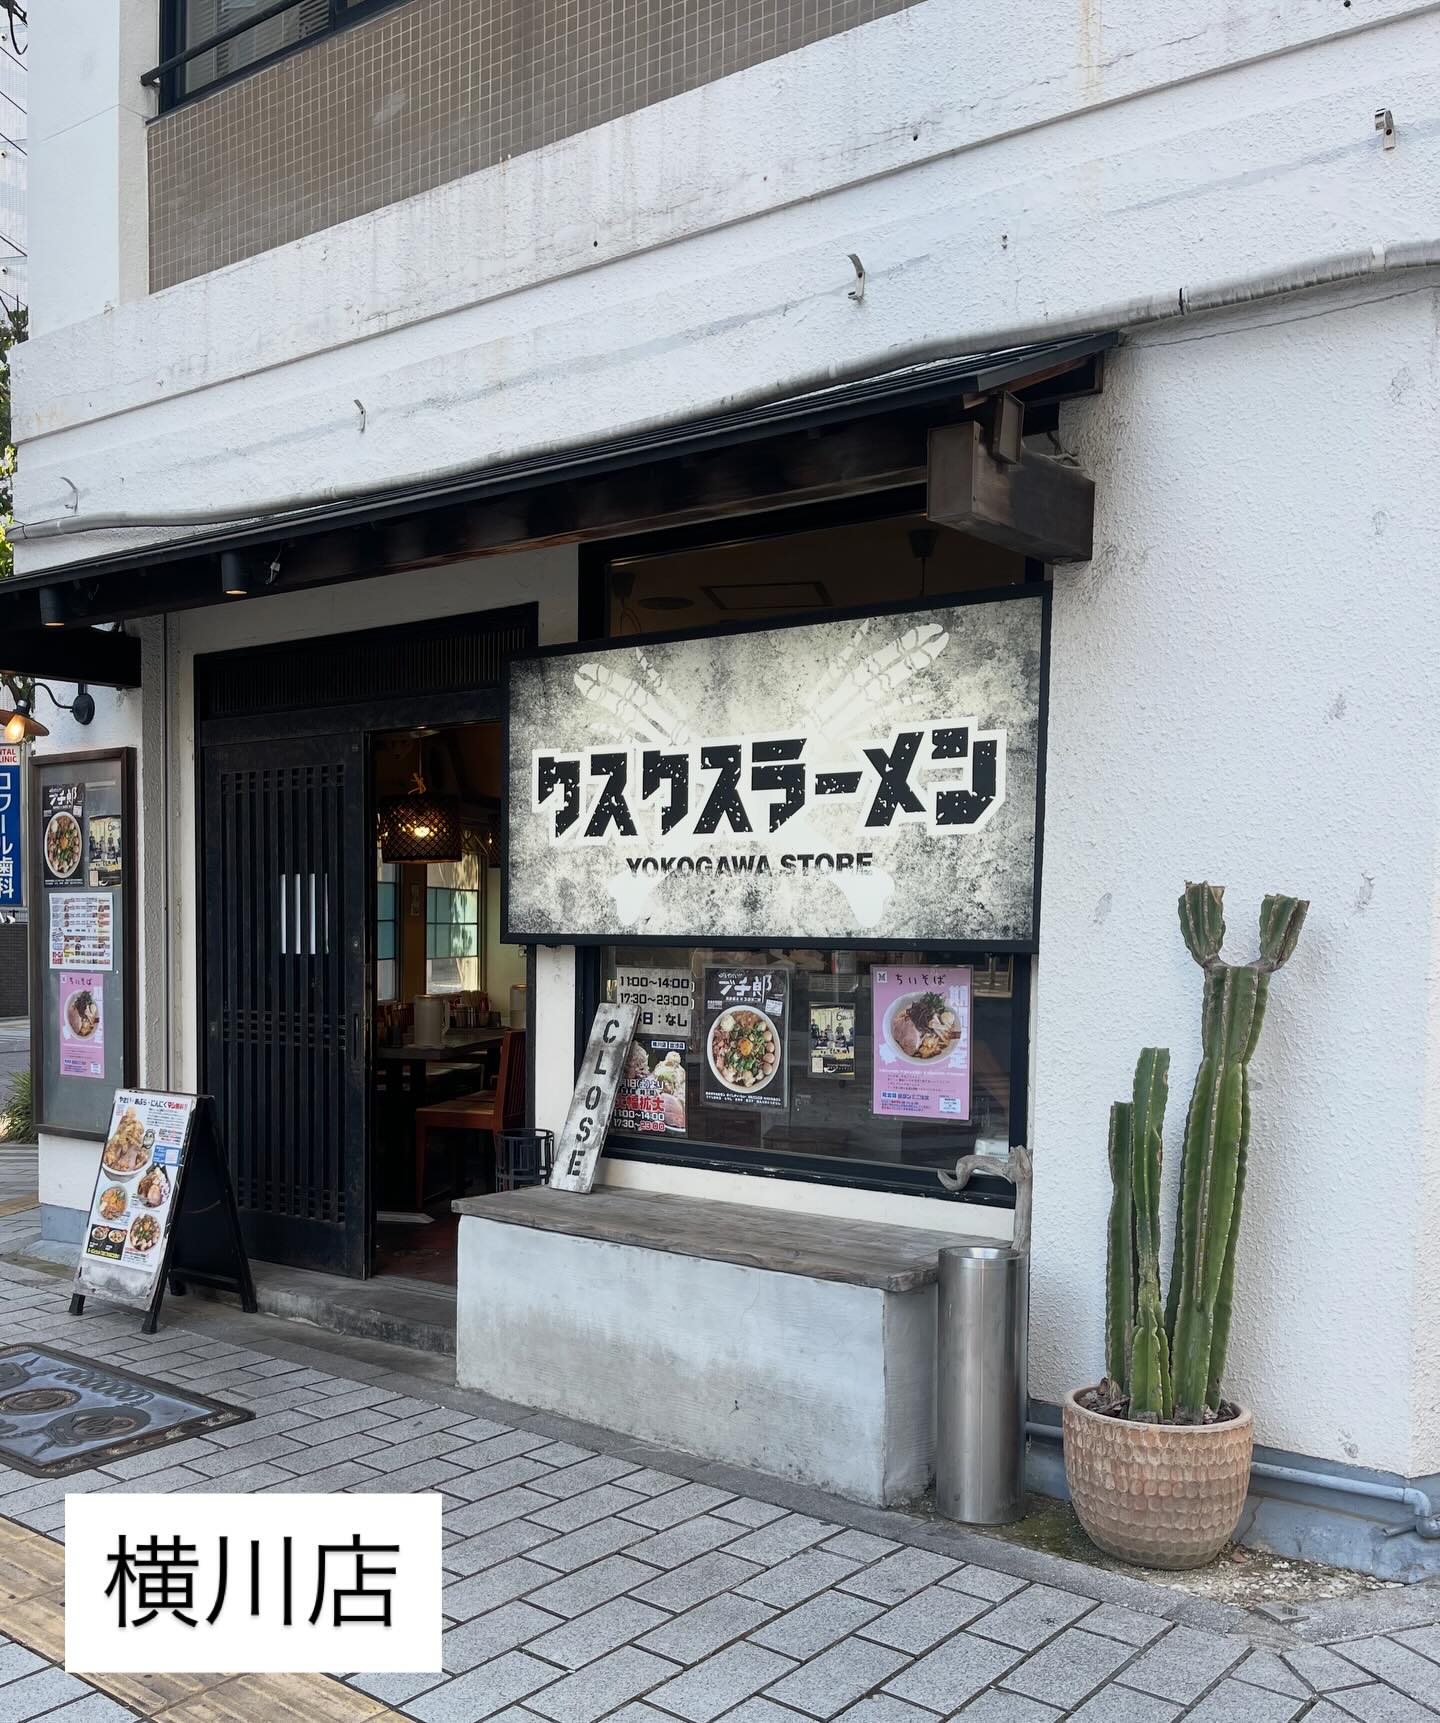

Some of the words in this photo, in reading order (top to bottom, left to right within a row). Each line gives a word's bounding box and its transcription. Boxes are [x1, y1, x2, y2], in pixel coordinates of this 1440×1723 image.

[537, 726, 998, 839] クスクスラーメン
[626, 855, 773, 878] YOKOGAWA
[780, 852, 873, 877] STORE
[895, 973, 946, 986] ちいそば
[567, 1019, 620, 1176] CLOSE
